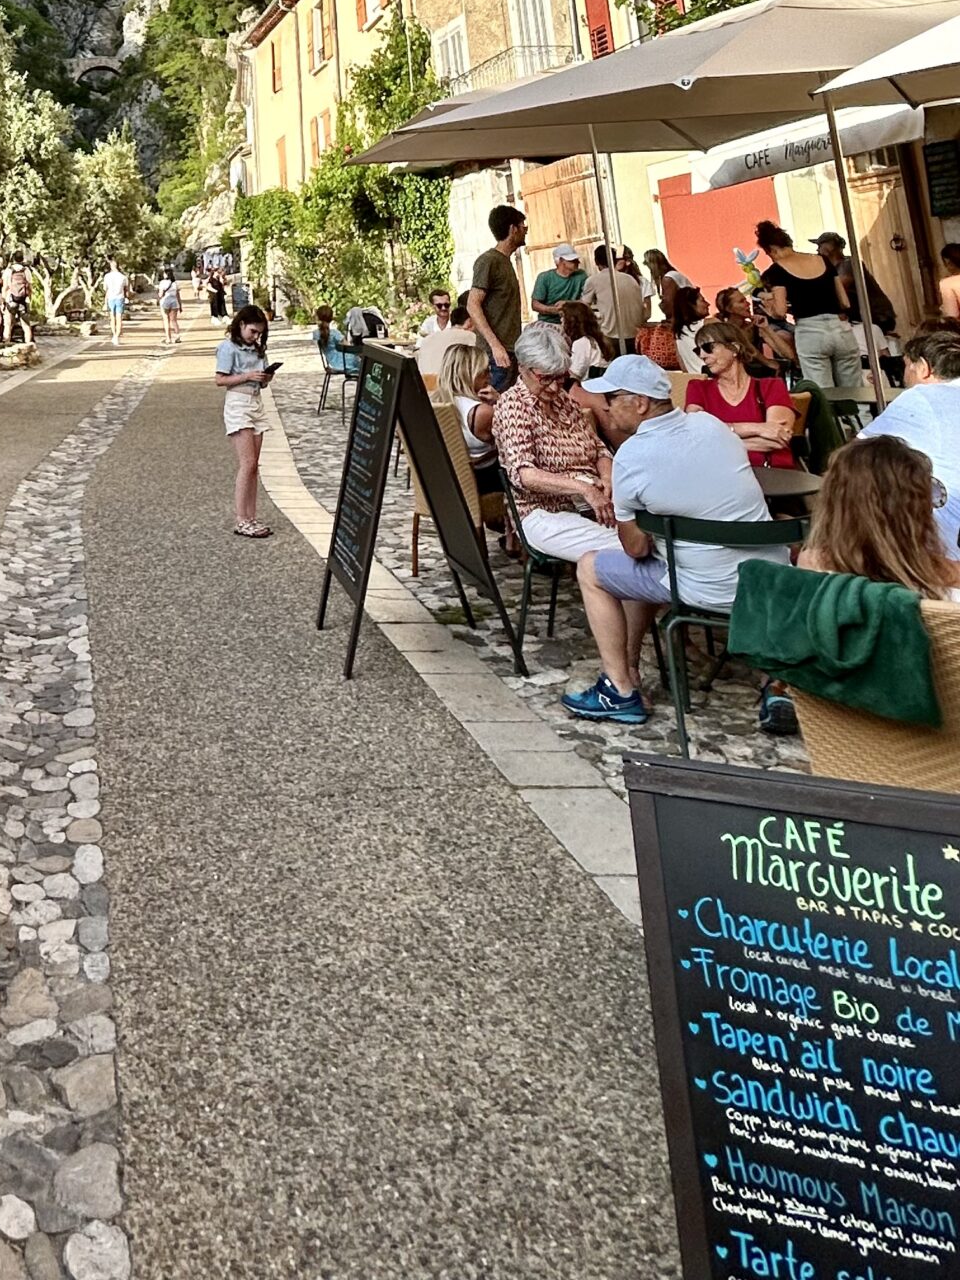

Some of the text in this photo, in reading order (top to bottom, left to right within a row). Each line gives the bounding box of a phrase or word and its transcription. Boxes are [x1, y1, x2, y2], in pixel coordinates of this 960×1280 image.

[744, 144, 771, 170] CAFÉ
[759, 816, 850, 859] CAFÉ
[694, 897, 874, 969] Charcuterie
[796, 896, 830, 915] BAR
[850, 905, 904, 929] TAPAS
[690, 948, 822, 1018] Fromage
[832, 990, 880, 1024] Bio
[896, 1006, 933, 1035] de
[744, 946, 774, 963] local
[776, 955, 811, 970] cured
[818, 965, 850, 979] meat
[917, 984, 956, 1003] bread
[728, 995, 758, 1013] local
[776, 1011, 825, 1031] organic
[831, 1023, 863, 1040] goat
[866, 1029, 916, 1048] cheese
[789, 1067, 818, 1082] olive
[862, 1057, 938, 1094] noire
[712, 1070, 960, 1158] Sandwich chau
[711, 1175, 735, 1195] Pois
[912, 1233, 956, 1252] cumin
[725, 1145, 957, 1238] Houmous Maison
[730, 1229, 815, 1280] Tarte
[898, 1246, 940, 1265] cumin
